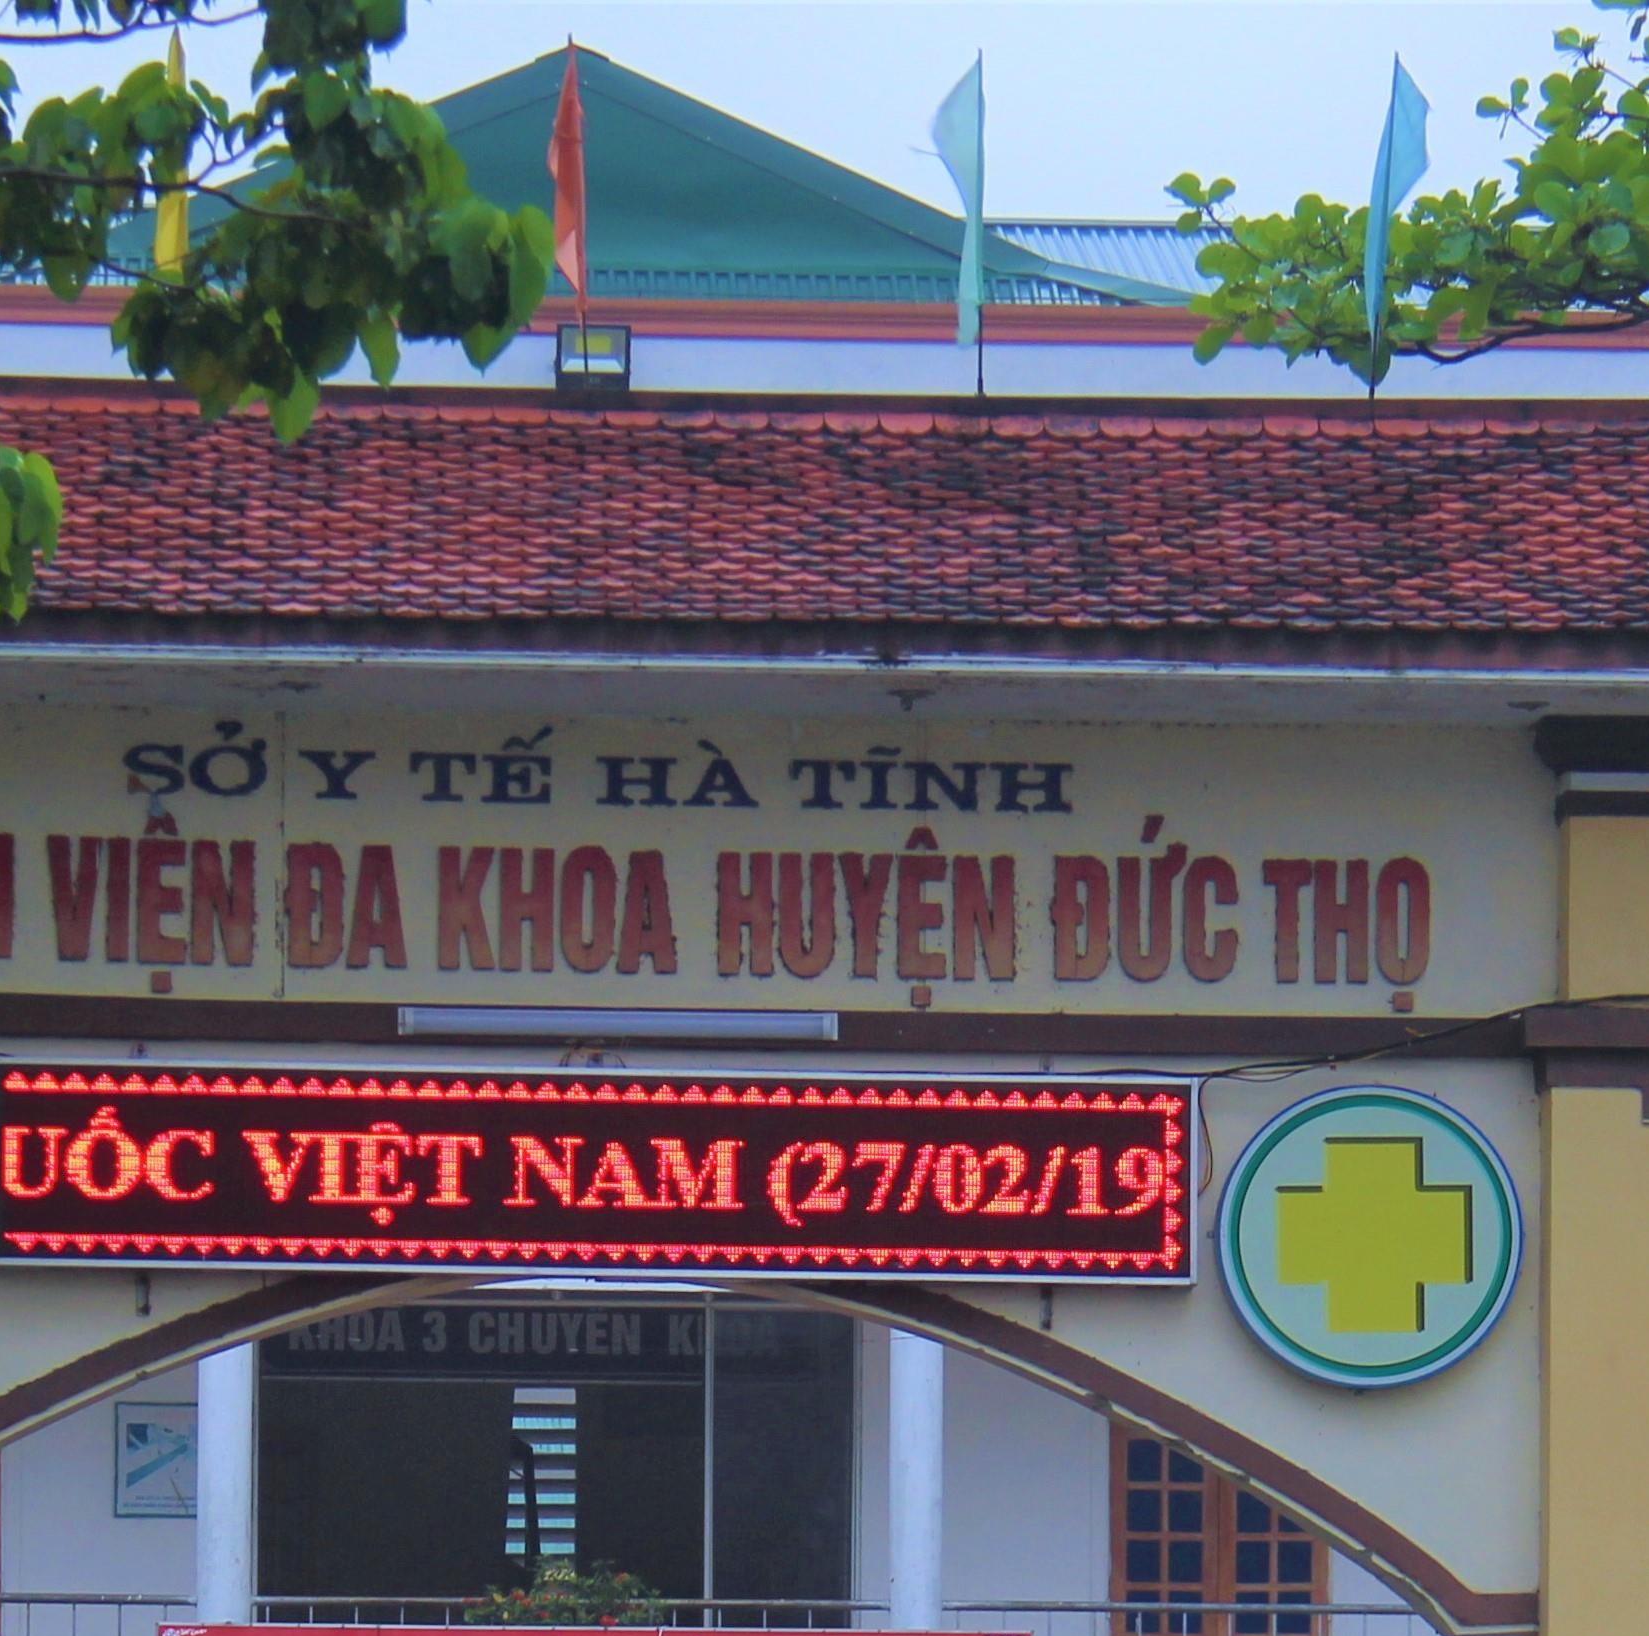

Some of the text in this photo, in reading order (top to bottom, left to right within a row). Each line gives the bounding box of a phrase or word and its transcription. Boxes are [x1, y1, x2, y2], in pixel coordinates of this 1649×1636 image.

[123, 719, 1073, 814] SỞ Y TẾ HÀ TĨNH
[47, 811, 256, 993] VIỆN
[286, 842, 408, 971] ĐA
[438, 843, 677, 975] KHOA
[716, 827, 1016, 1008] HUYỆN
[1050, 815, 1240, 985] ĐỨC
[1262, 857, 1431, 1012] THỌ
[1, 1107, 214, 1201] UỐC
[241, 1121, 482, 1226] VIỆT
[504, 1134, 746, 1210] NAM
[287, 1311, 405, 1353] KHOA
[422, 1312, 447, 1354] 3
[468, 1304, 641, 1354] CHUYÊN
